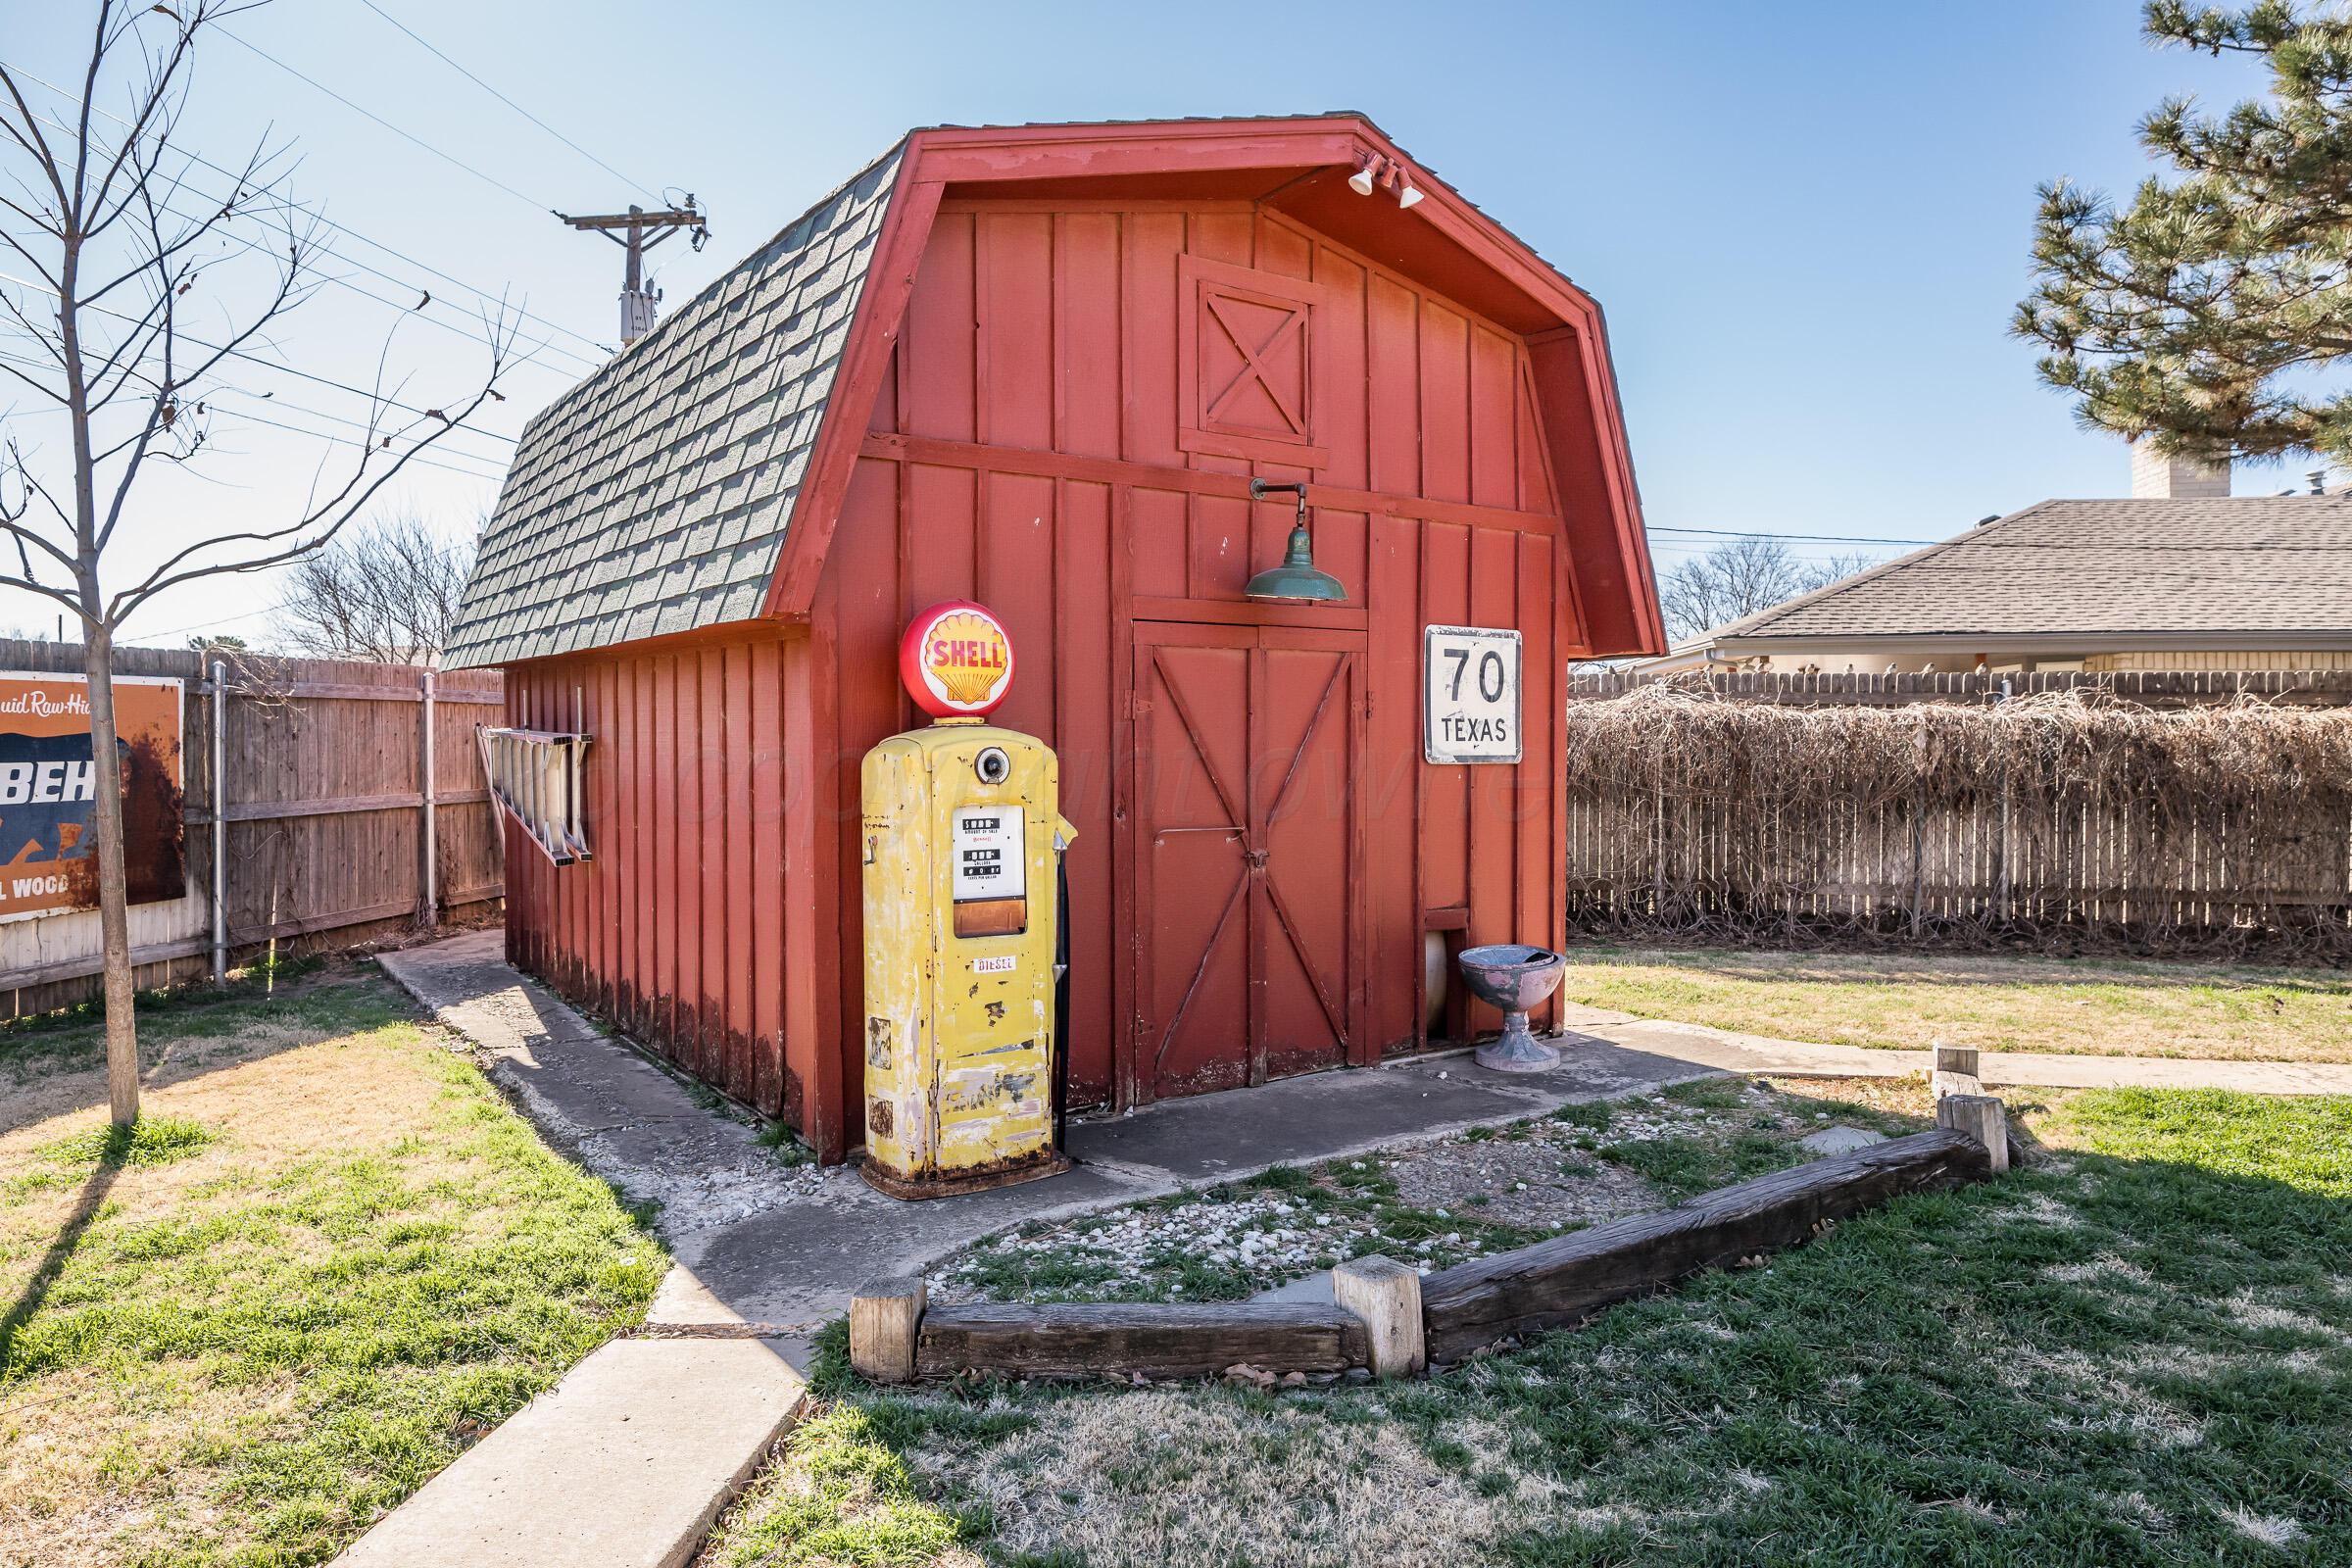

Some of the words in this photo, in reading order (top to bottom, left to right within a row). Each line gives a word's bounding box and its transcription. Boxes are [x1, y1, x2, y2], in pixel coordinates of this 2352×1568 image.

[933, 640, 1003, 668] SHELL
[1444, 648, 1504, 704] 70
[1441, 717, 1506, 742] TEXAS
[0, 760, 96, 805] BEH
[979, 956, 1012, 971] DIESEL
